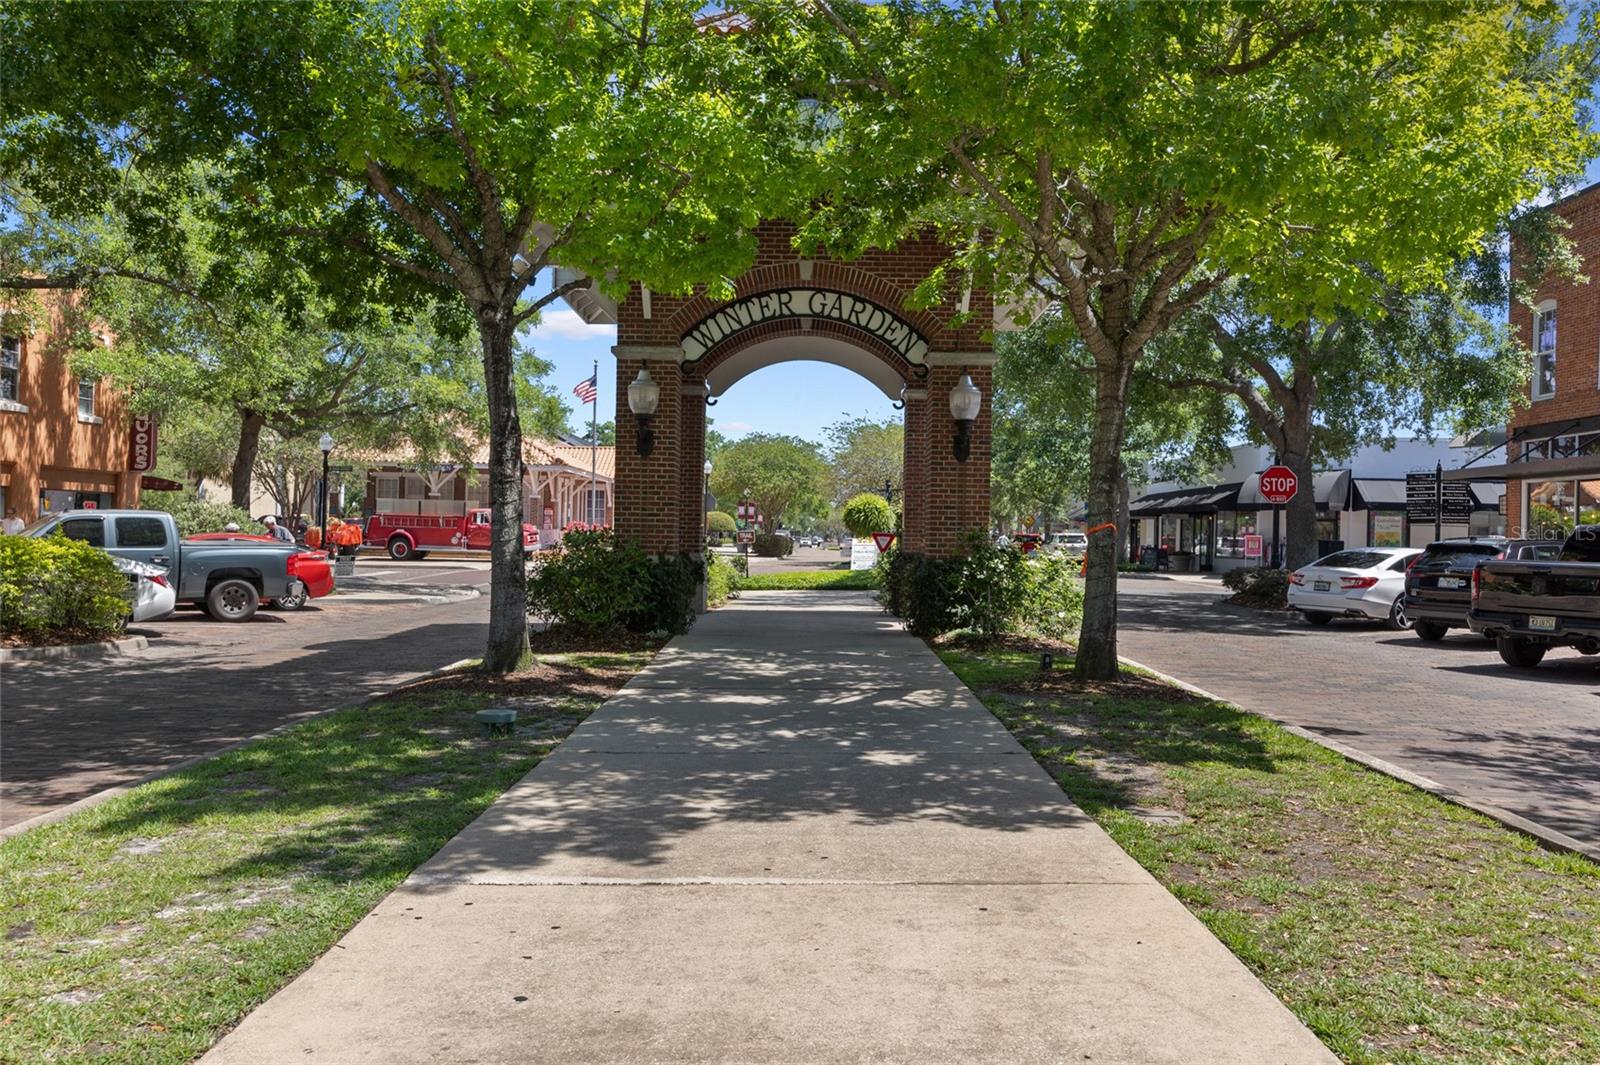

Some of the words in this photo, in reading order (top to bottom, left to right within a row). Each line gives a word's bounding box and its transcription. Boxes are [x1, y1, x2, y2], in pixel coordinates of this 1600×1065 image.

[692, 292, 792, 351] WINTER
[808, 291, 926, 356] GARDEN
[1262, 477, 1295, 492] STOP
